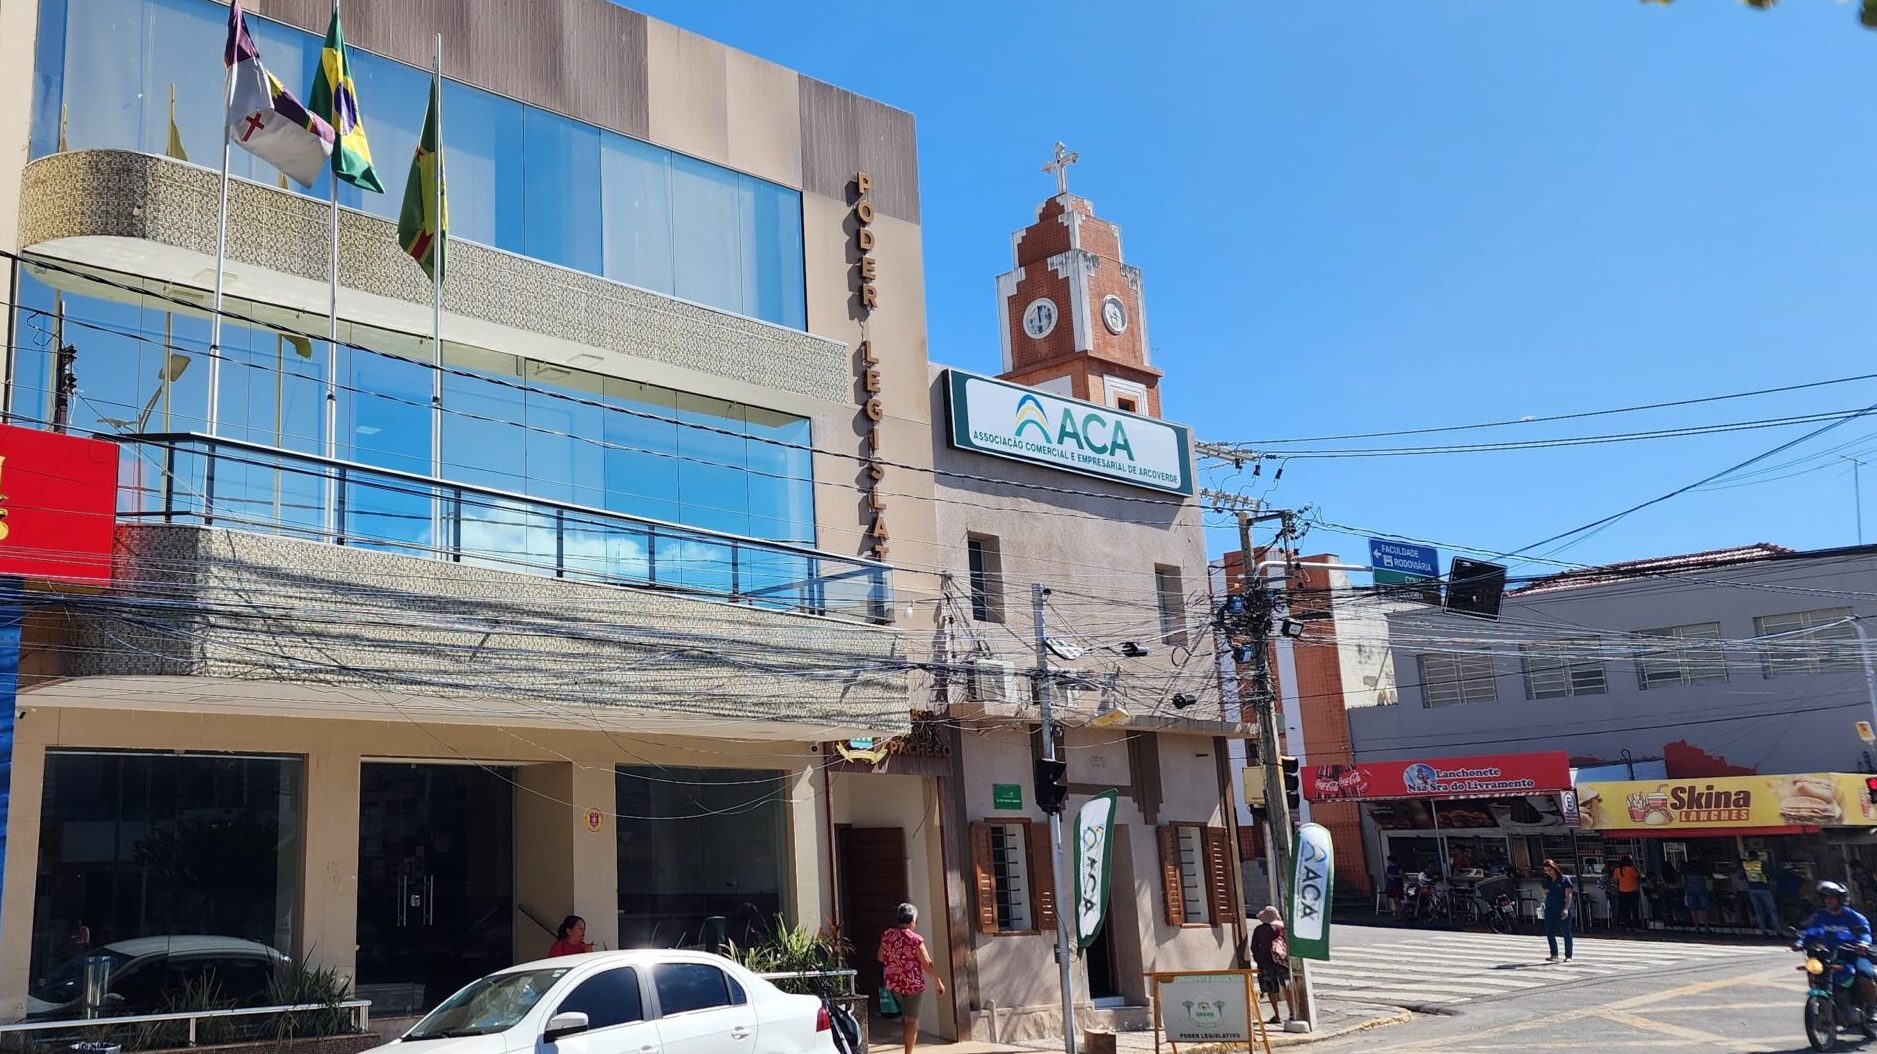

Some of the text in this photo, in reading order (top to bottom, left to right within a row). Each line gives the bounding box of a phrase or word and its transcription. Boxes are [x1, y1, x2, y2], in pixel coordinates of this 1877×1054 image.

[857, 171, 877, 311] PODER
[1057, 407, 1135, 462] ACA
[973, 430, 1179, 484] ASSOCIAÇÃO COMERCIAL E EMPRESARIAL DE ARCOVERDE
[1381, 545, 1418, 557] FACULDADE
[1394, 558, 1432, 571] RODOVIÁRIA
[1436, 767, 1500, 780] Lanchonete
[1408, 778, 1535, 793] Nsa Sra do Livramento
[1670, 785, 1751, 810] Skina
[1681, 809, 1748, 821] LANCHES
[1301, 865, 1323, 921] ACA
